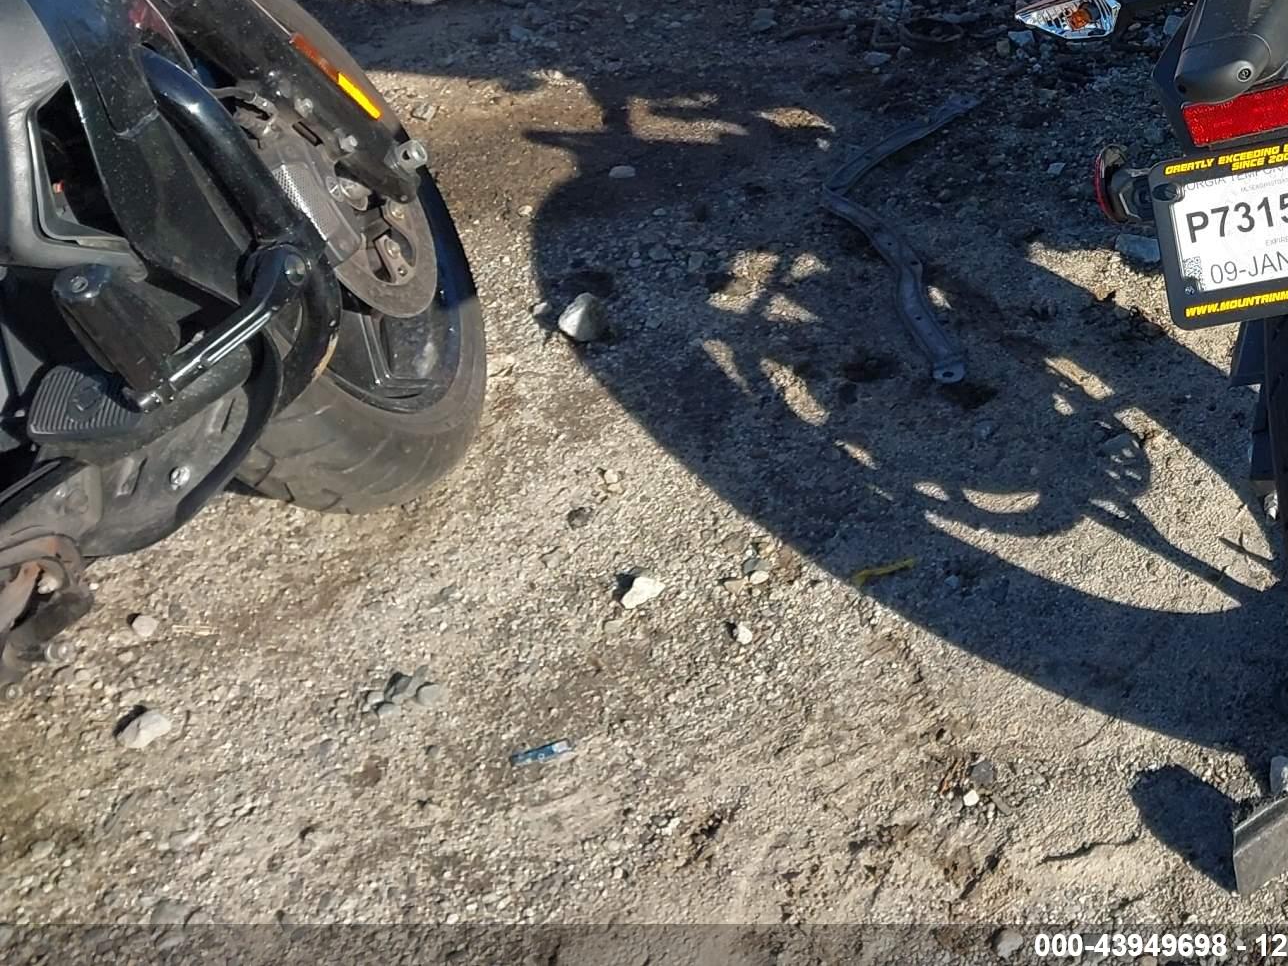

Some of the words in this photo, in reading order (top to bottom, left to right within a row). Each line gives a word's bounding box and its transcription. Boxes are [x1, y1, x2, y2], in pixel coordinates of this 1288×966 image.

[1165, 158, 1215, 175] GREATLY
[1218, 146, 1280, 165] EXCEEDING
[1231, 157, 1265, 171] SINCE
